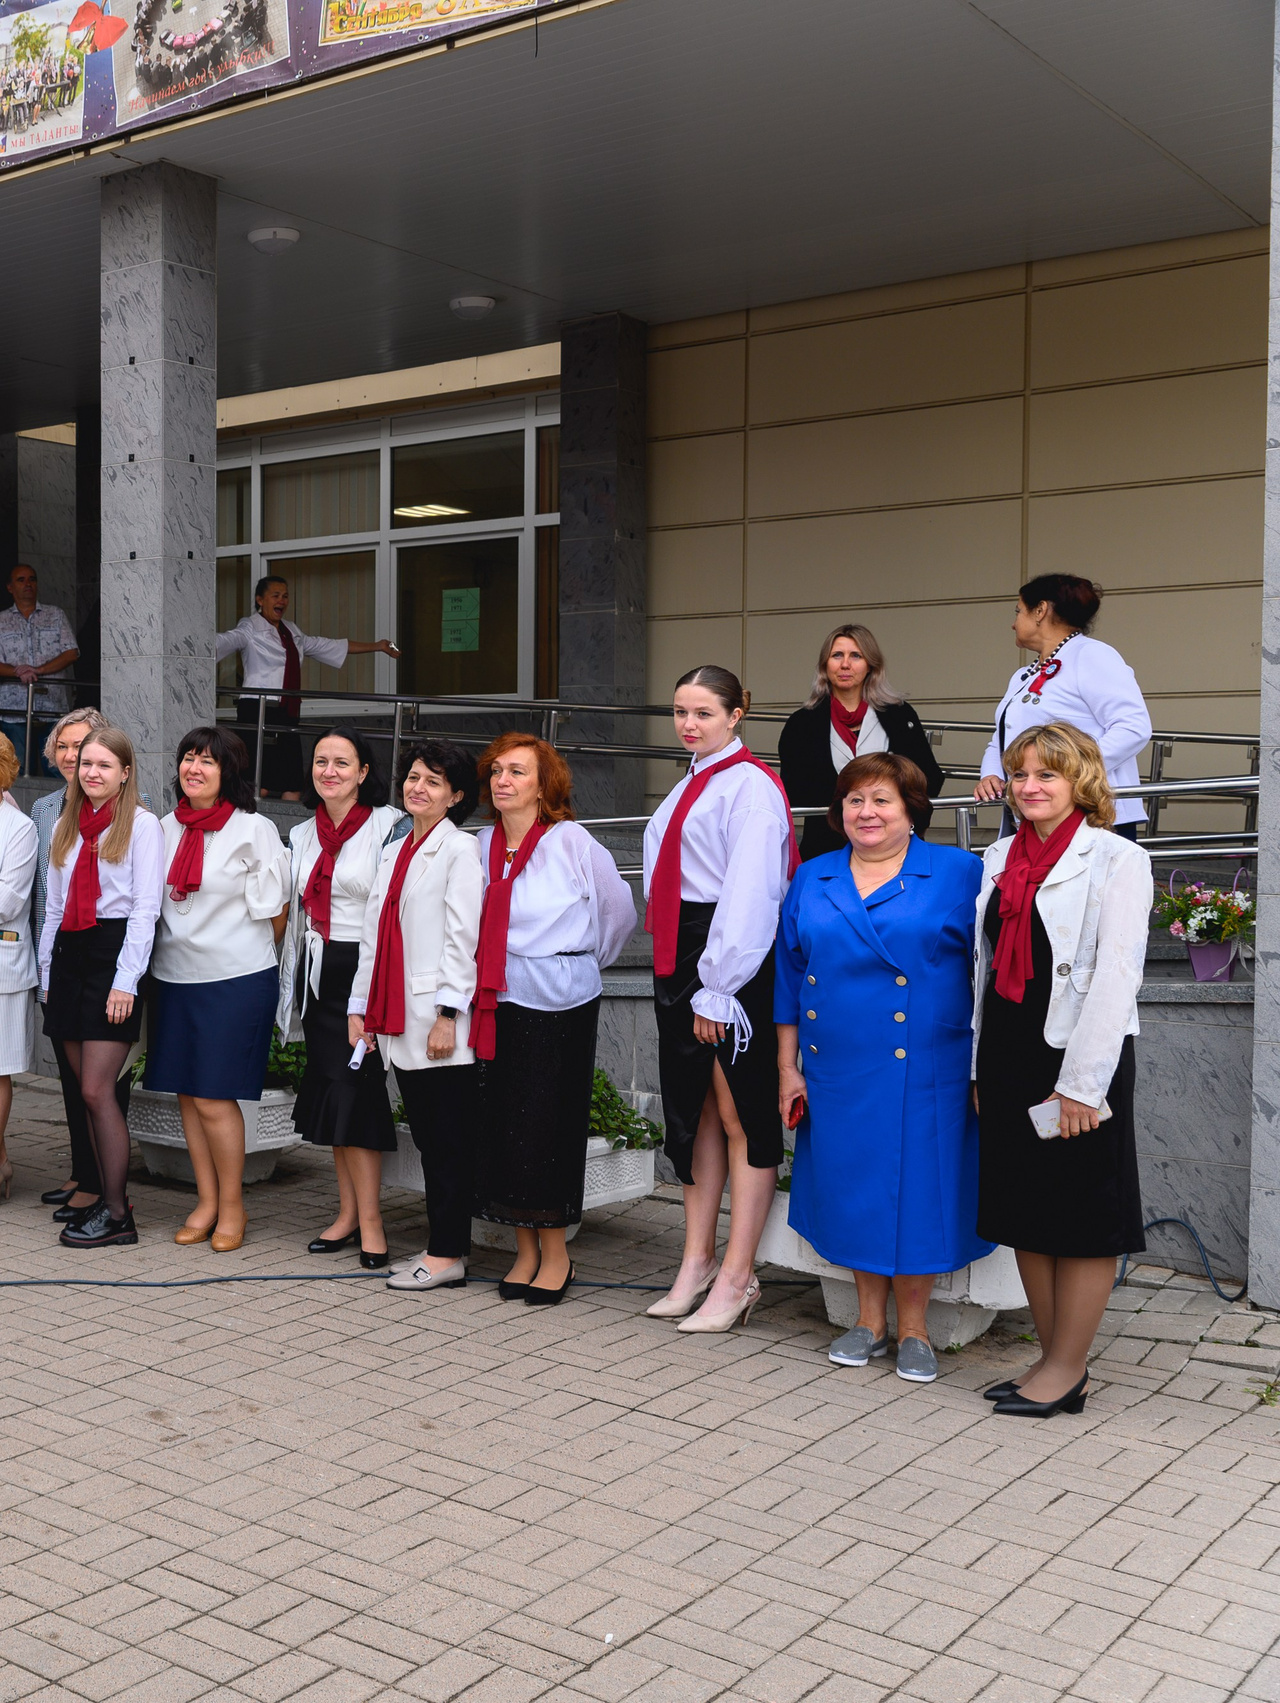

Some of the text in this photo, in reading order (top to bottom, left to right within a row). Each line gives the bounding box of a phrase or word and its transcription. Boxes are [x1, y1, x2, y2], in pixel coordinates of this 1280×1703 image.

[128, 81, 187, 113] Начинаем
[188, 67, 206, 88] год
[11, 125, 79, 149] МЫ ТАЛАНТЫ!
